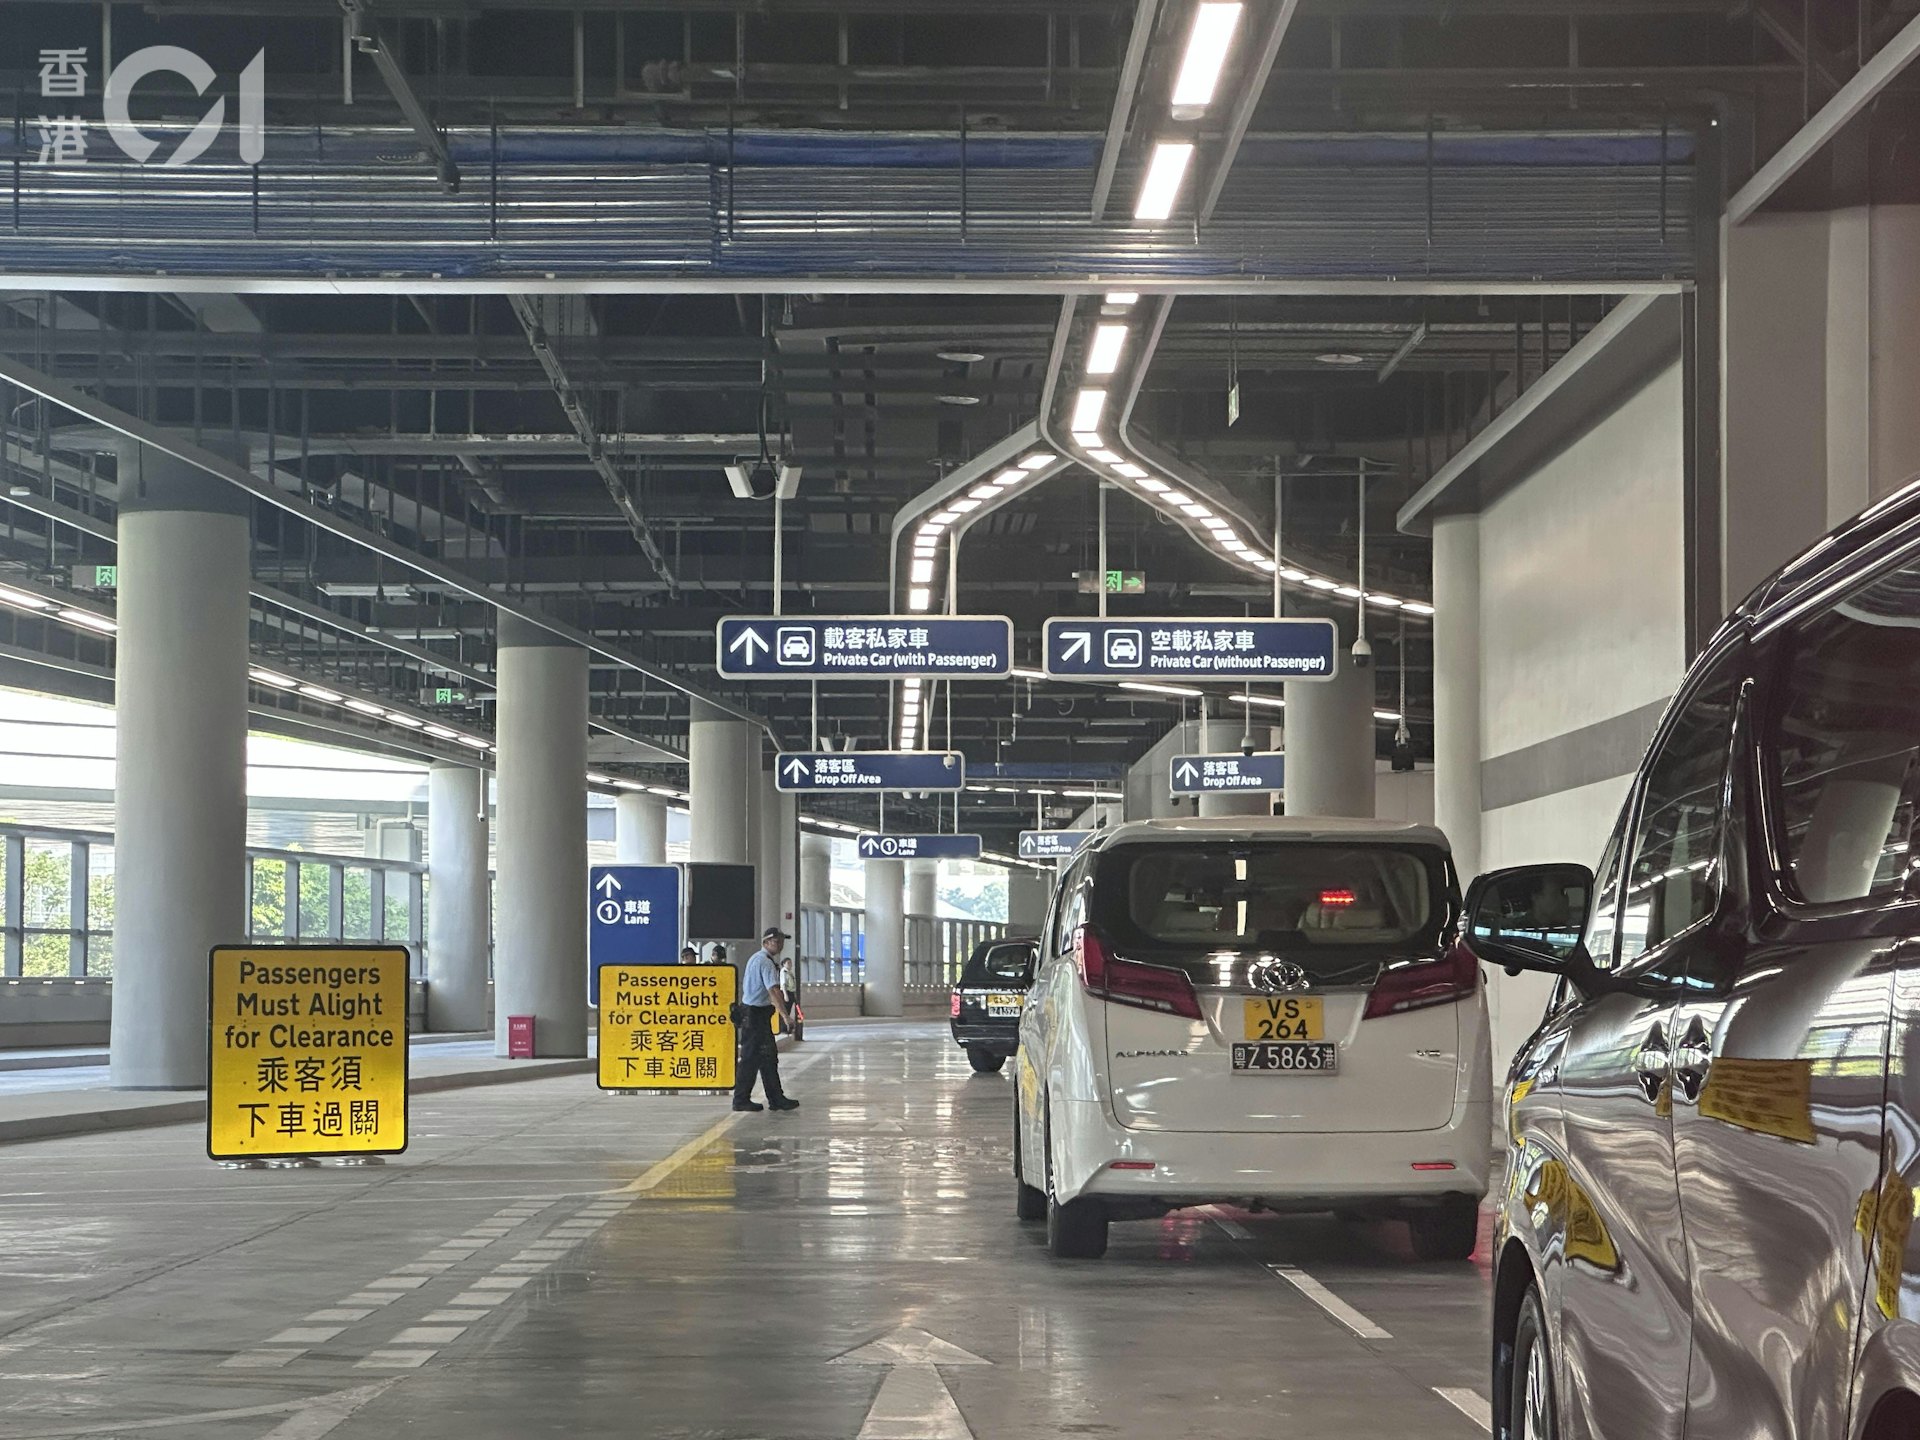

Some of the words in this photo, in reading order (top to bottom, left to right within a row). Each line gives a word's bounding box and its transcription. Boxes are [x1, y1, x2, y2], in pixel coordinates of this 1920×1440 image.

[824, 627, 929, 649] 載客私家車
[1151, 630, 1255, 651] 空載私家車
[824, 652, 868, 666] Private
[870, 653, 892, 666] Car
[894, 652, 925, 667] (with
[928, 652, 996, 669] Passenger)
[1150, 656, 1191, 668] Private
[1192, 656, 1212, 668] Car
[1214, 655, 1262, 670] (without
[1264, 656, 1325, 672] Passenger)
[815, 759, 855, 773] 落客區
[1203, 761, 1239, 776] 落客區
[815, 774, 839, 786] Drop
[840, 774, 857, 784] Off
[858, 774, 881, 784] Area
[1203, 776, 1224, 788] Drop
[1226, 776, 1241, 786] Off
[1241, 776, 1262, 786] Area
[1038, 846, 1050, 854] Drop
[624, 900, 650, 914] 車道
[624, 915, 649, 924] Lane
[240, 960, 381, 988] Passengers
[618, 972, 717, 991] Passengers
[237, 992, 300, 1016] Must
[309, 992, 382, 1020] Alight
[616, 992, 659, 1006] Must
[666, 991, 718, 1009] Alight
[1266, 999, 1300, 1019] VS
[608, 1011, 632, 1025] for
[639, 1010, 727, 1025] Clearance
[225, 1025, 260, 1048] for
[269, 1024, 393, 1048] Clearance
[1258, 1019, 1308, 1038] 264
[631, 1030, 704, 1052] 乘客須
[1116, 1050, 1188, 1058] ALPHARD
[257, 1056, 362, 1094] 乘客須
[618, 1056, 717, 1079] 下車過關
[238, 1100, 379, 1138] 下車過關
